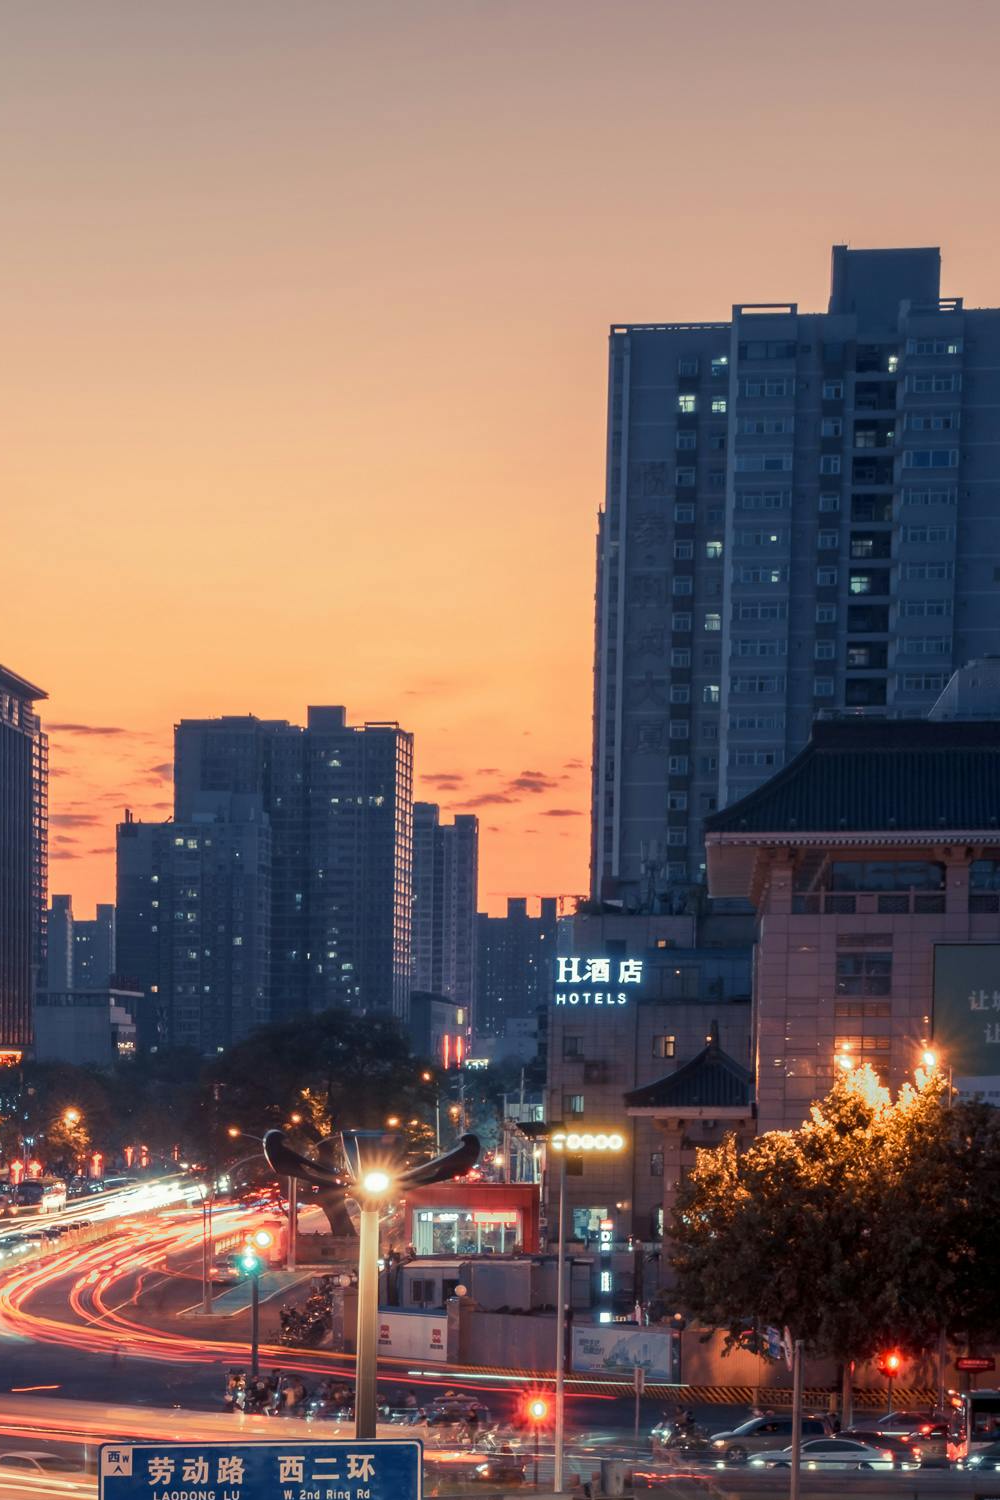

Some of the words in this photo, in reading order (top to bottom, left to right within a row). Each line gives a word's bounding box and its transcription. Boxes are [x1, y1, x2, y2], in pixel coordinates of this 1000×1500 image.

[556, 992, 626, 1005] HOTELS
[108, 1451, 120, 1463] 西
[122, 1455, 130, 1463] W
[148, 1456, 246, 1485] 劳动路
[277, 1454, 376, 1483] 西二环
[224, 1491, 240, 1500] LU
[283, 1490, 295, 1500] W.
[299, 1489, 320, 1500] 2nd
[357, 1489, 371, 1499] Rd
